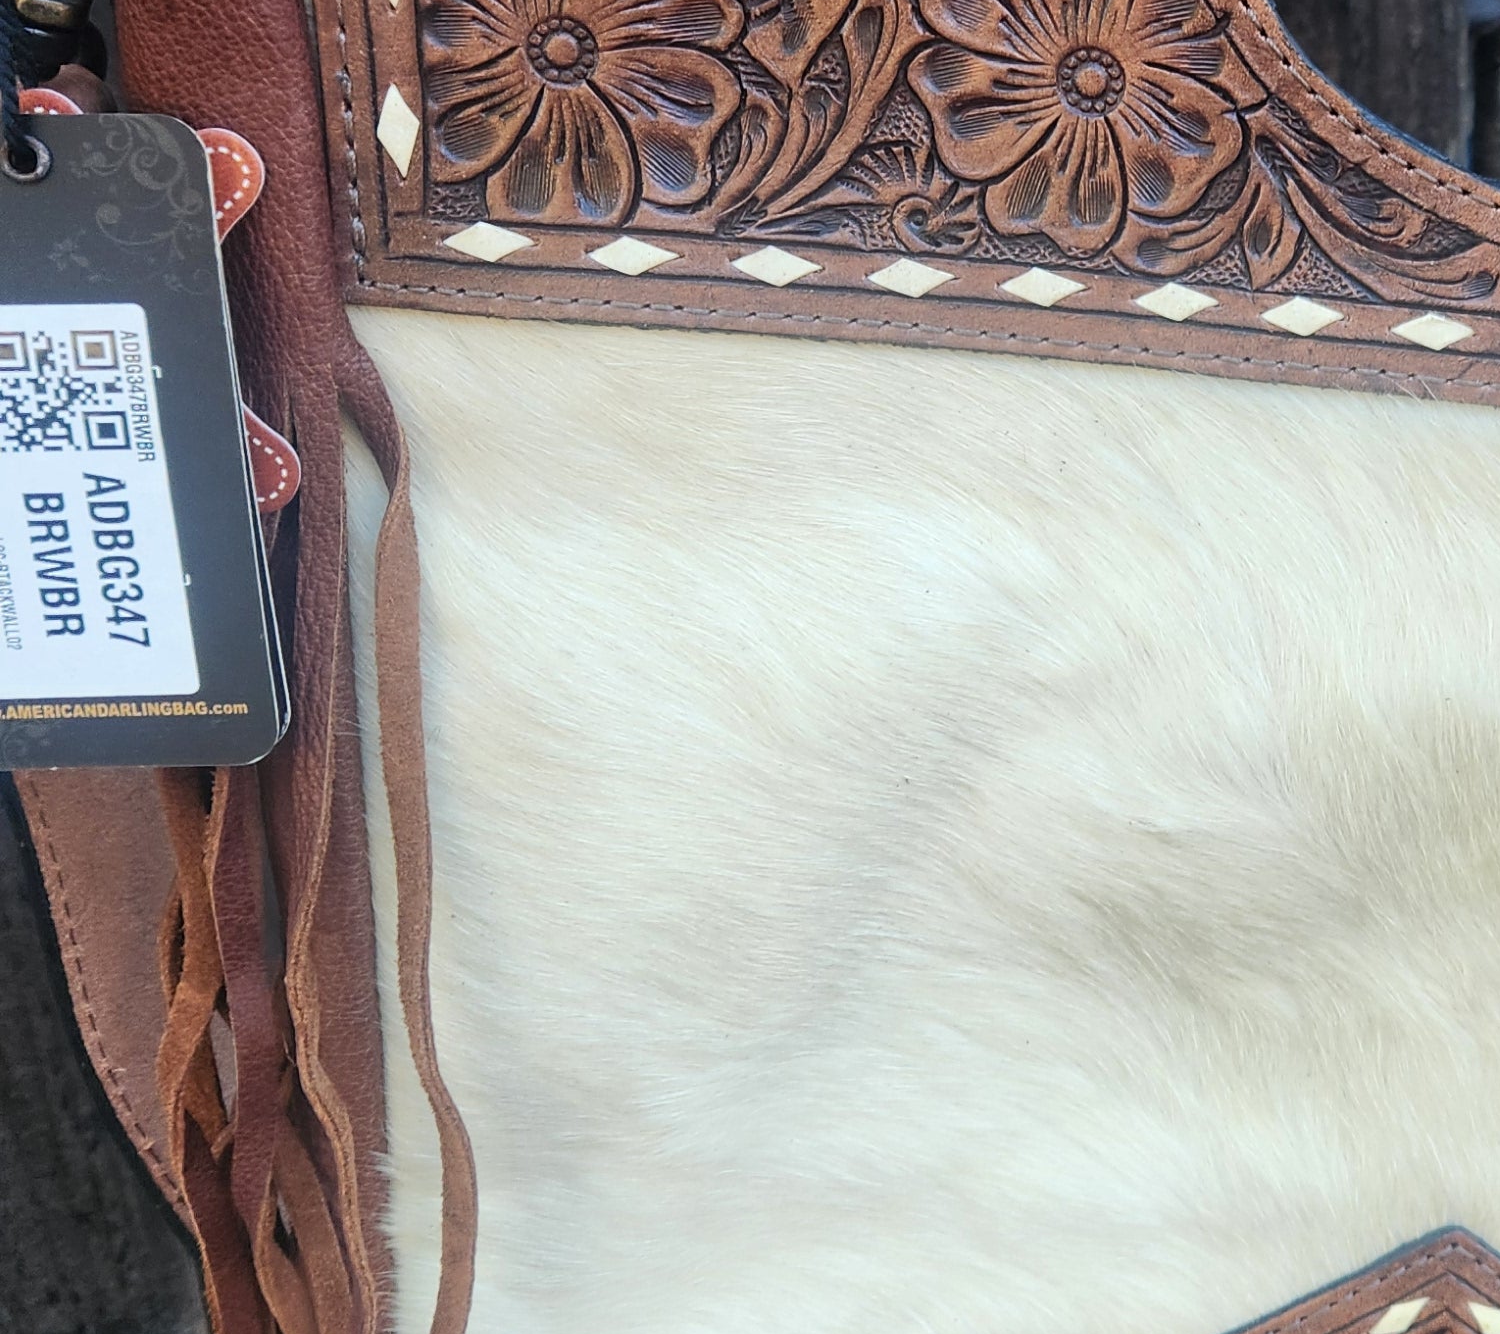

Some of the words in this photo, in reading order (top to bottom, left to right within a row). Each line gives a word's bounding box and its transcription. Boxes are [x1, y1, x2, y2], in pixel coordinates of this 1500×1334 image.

[119, 330, 156, 463] ADBG347BRWBR
[22, 491, 86, 637] BRWBR
[82, 472, 151, 648] ADBG347
[0, 701, 248, 720] .AMERICANDARLINGBAG.com
